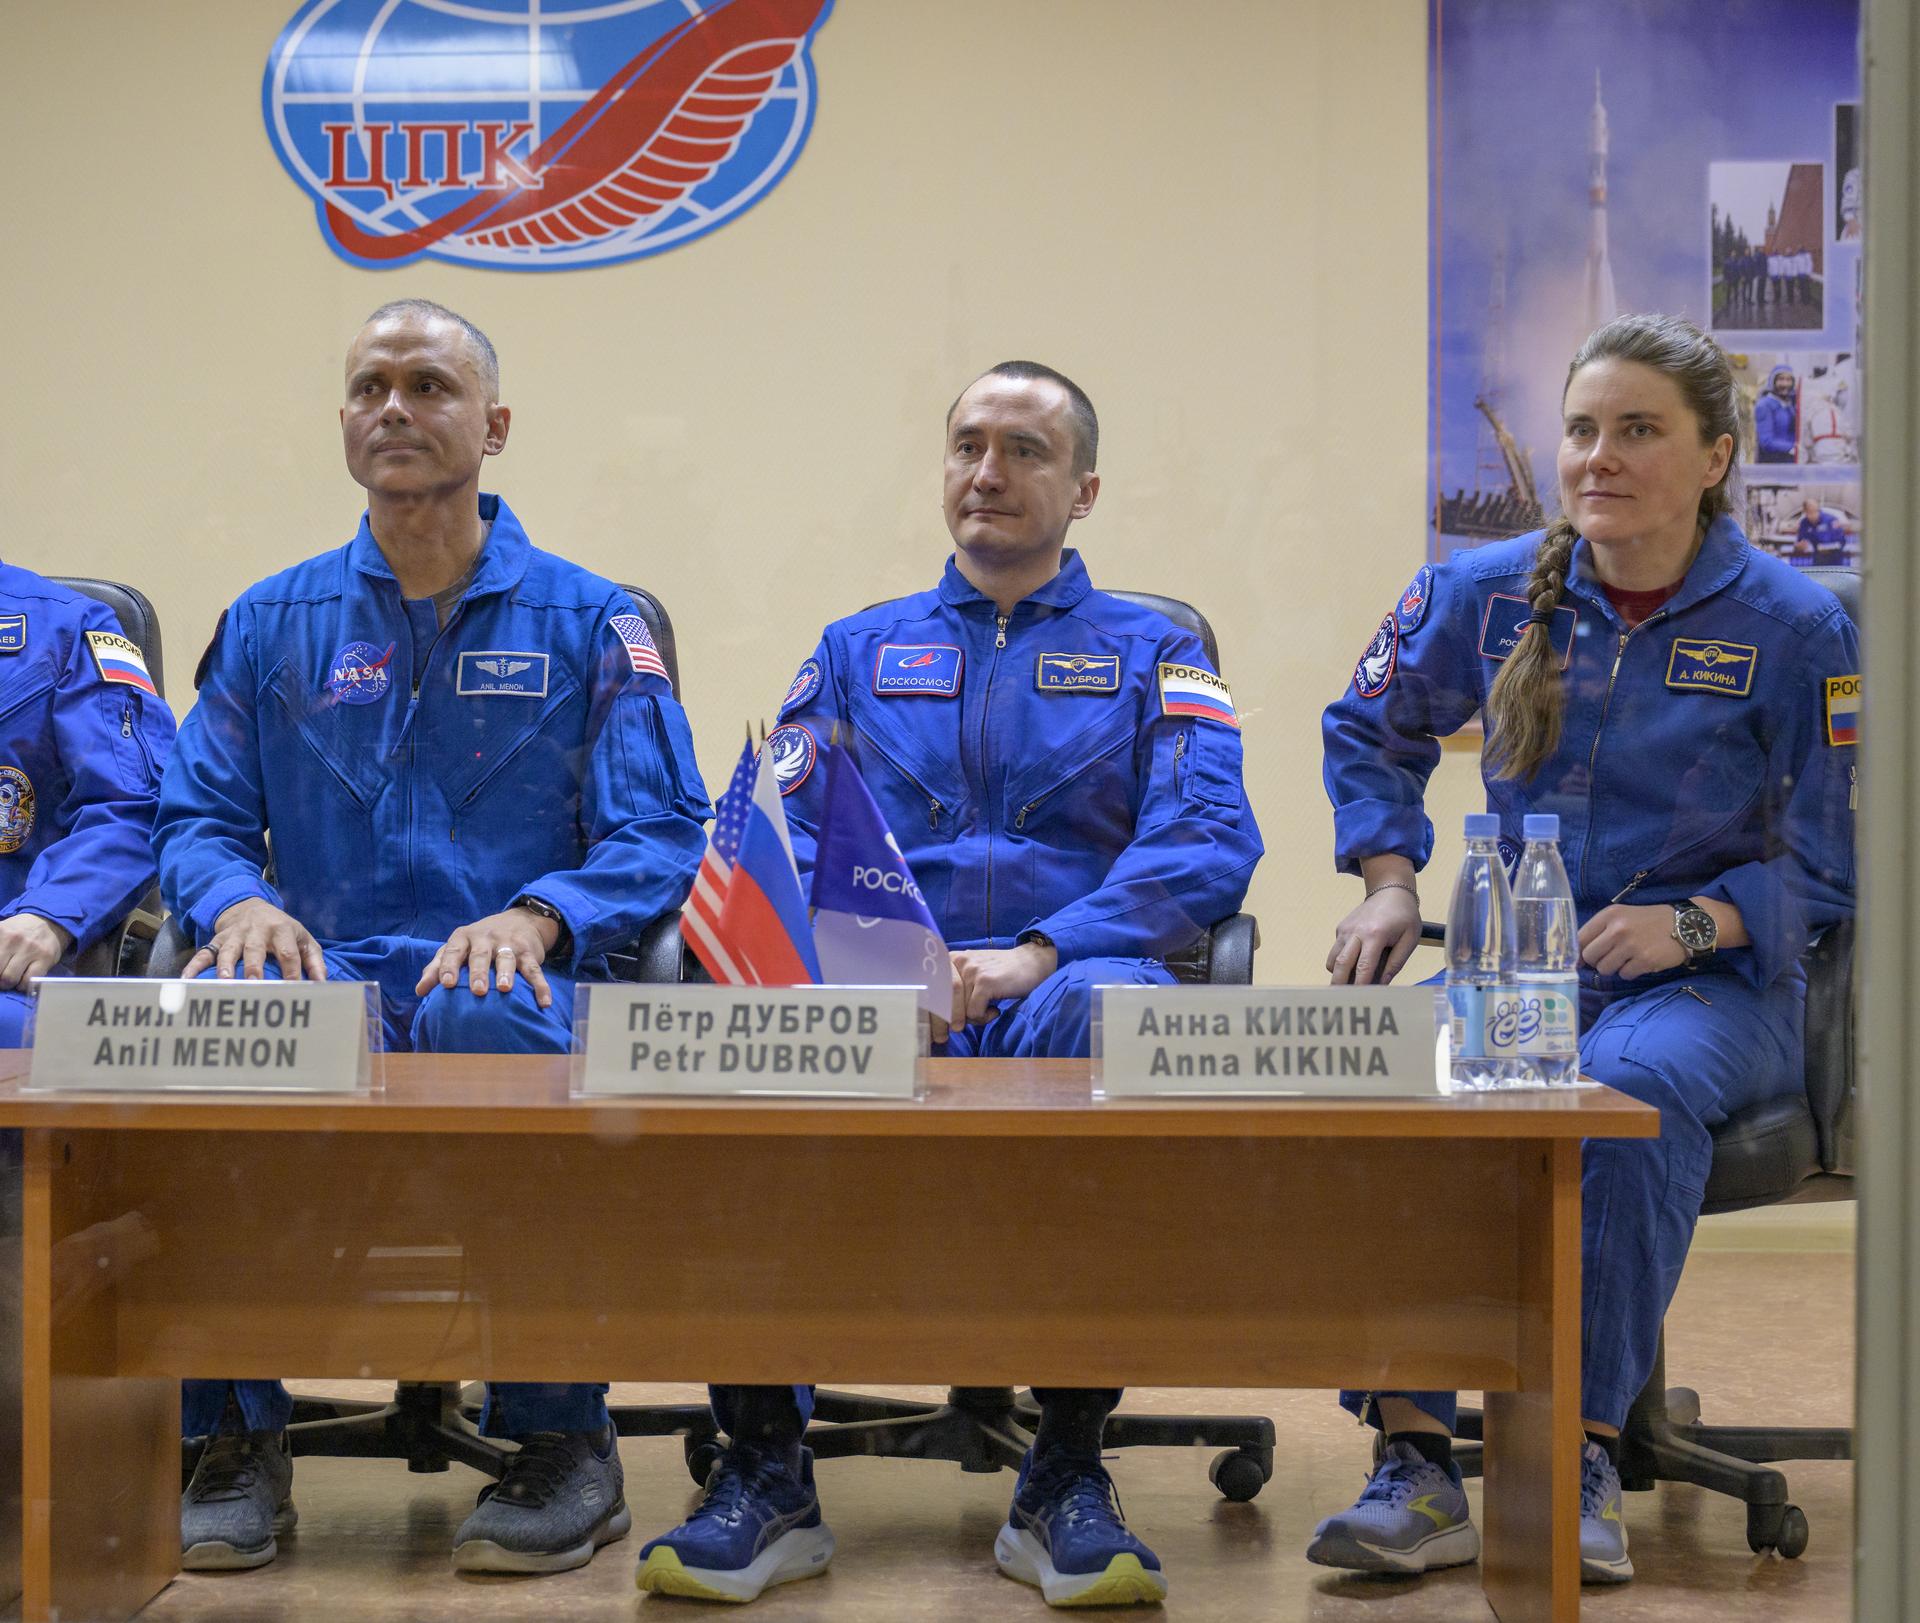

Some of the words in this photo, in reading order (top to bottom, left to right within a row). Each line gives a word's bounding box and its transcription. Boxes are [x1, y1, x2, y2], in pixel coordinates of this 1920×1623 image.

[323, 122, 544, 201] ЦПК
[334, 667, 388, 681] NASA
[499, 683, 524, 691] MENON
[881, 677, 952, 688] РОСКОСМОС
[1049, 675, 1060, 683] П.
[1063, 675, 1108, 685] ДУБРОВ
[1163, 667, 1228, 693] РОССИЯ
[1692, 670, 1737, 686] КИКИНА
[87, 997, 174, 1027] Анил
[187, 999, 312, 1028] МЕНОН
[627, 1002, 715, 1038] Пётр
[726, 1003, 879, 1039] ДУБРОВ
[1137, 1006, 1231, 1036] Анна
[1245, 1006, 1400, 1037] КИКИНА
[93, 1036, 161, 1067] Anil
[173, 1037, 297, 1068] MENON
[630, 1041, 706, 1072] Petr
[719, 1043, 873, 1075] DUBROV
[1149, 1046, 1240, 1077] Anna
[1254, 1046, 1390, 1077] KIKINA
